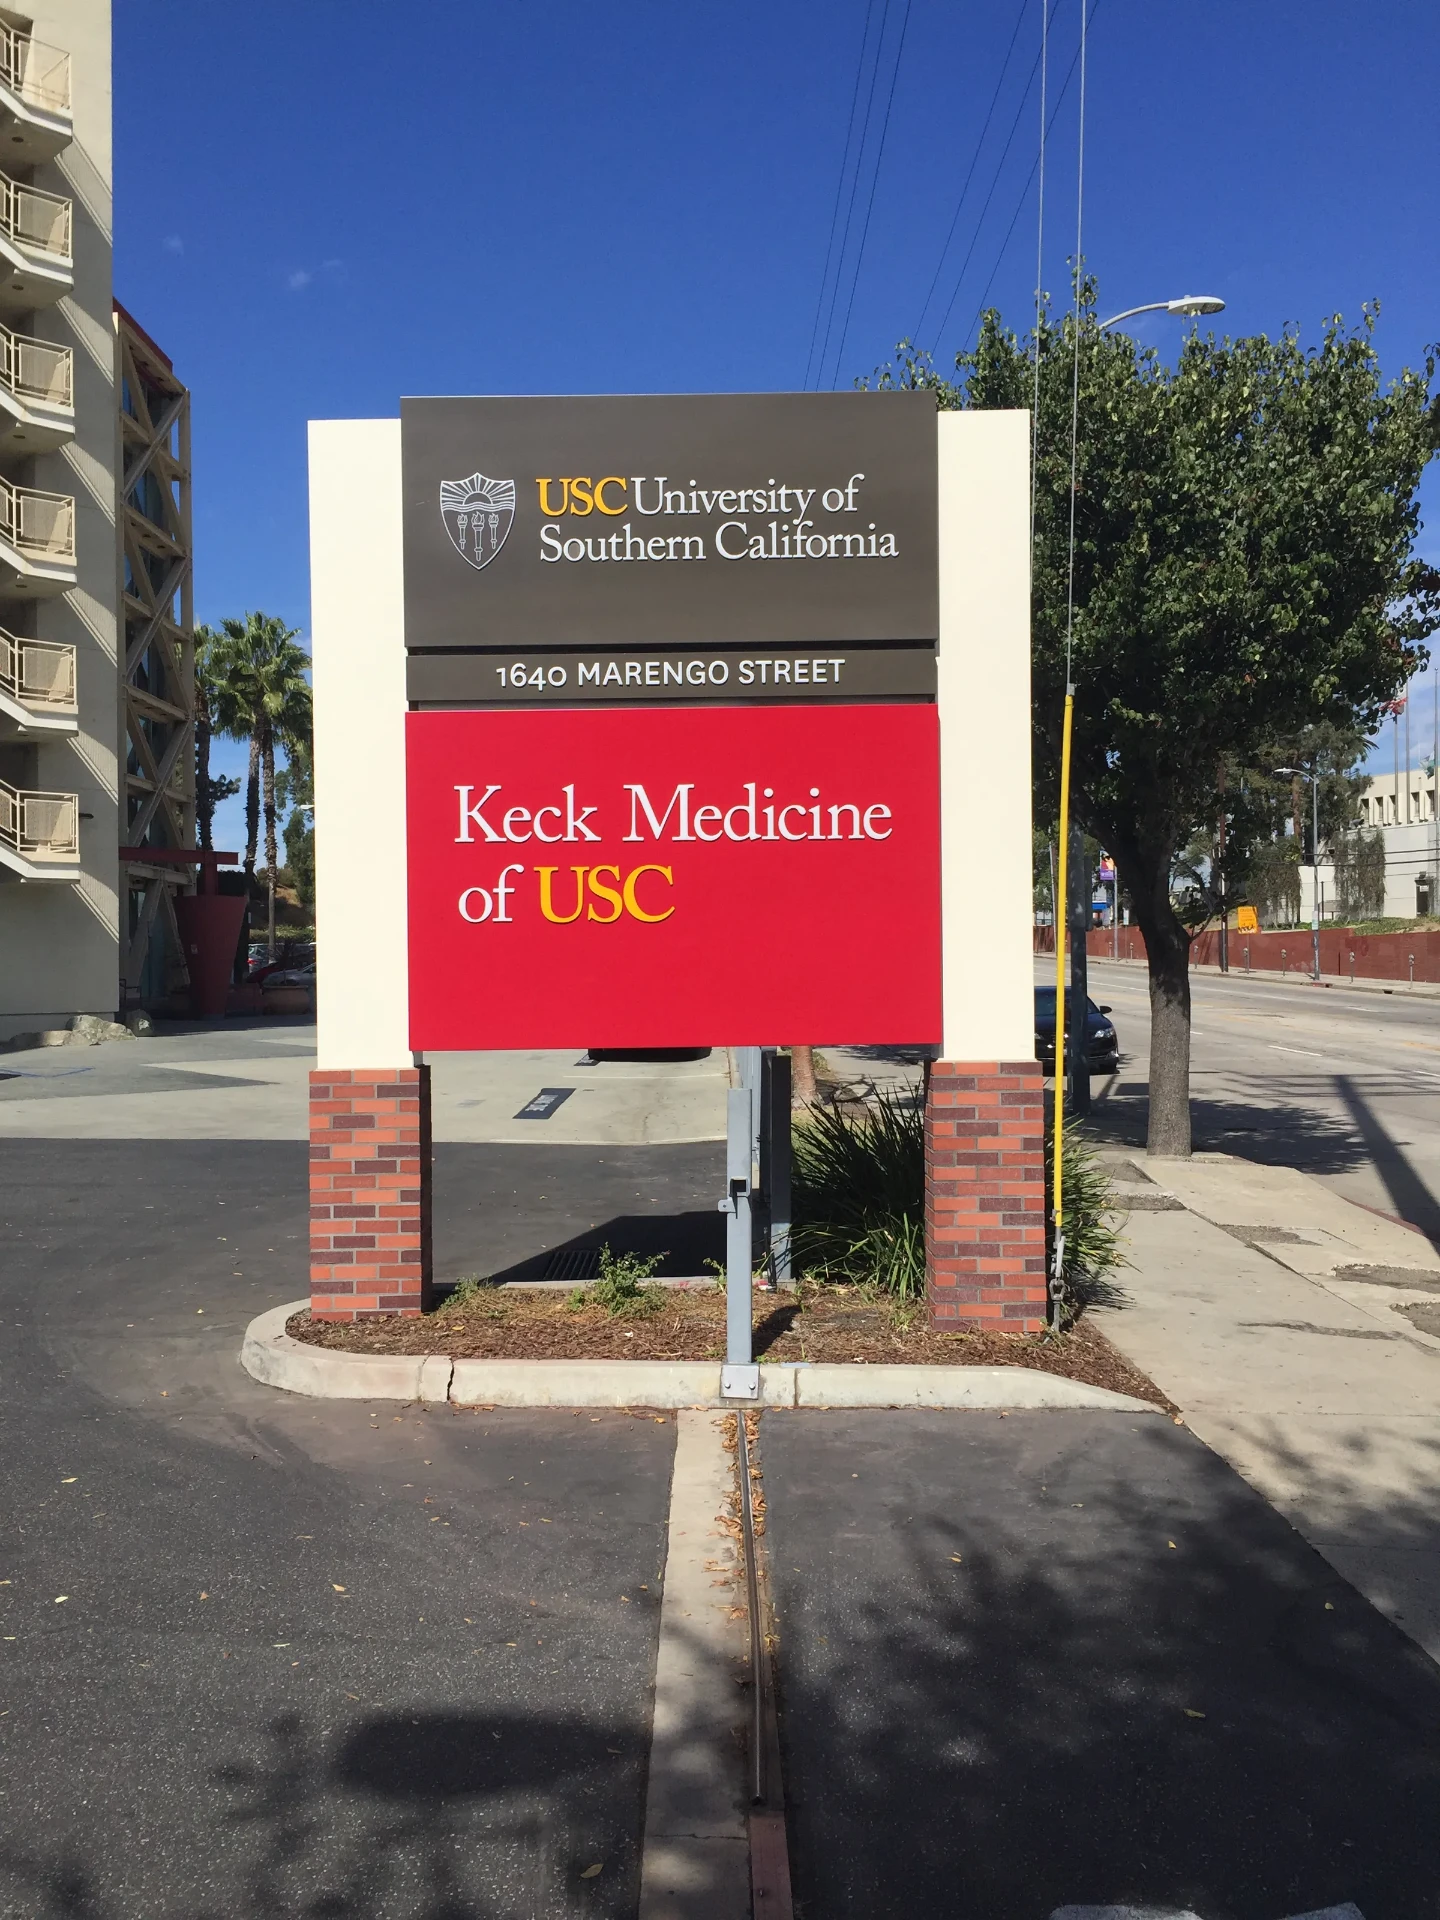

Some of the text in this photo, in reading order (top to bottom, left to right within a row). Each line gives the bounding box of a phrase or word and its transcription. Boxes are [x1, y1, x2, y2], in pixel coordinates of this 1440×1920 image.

[536, 473, 865, 525] USC University of
[539, 520, 900, 562] Southern California
[495, 659, 846, 691] 1640 MARENGO STREET
[453, 782, 893, 843] Keck Medicine
[457, 863, 676, 924] of USC
